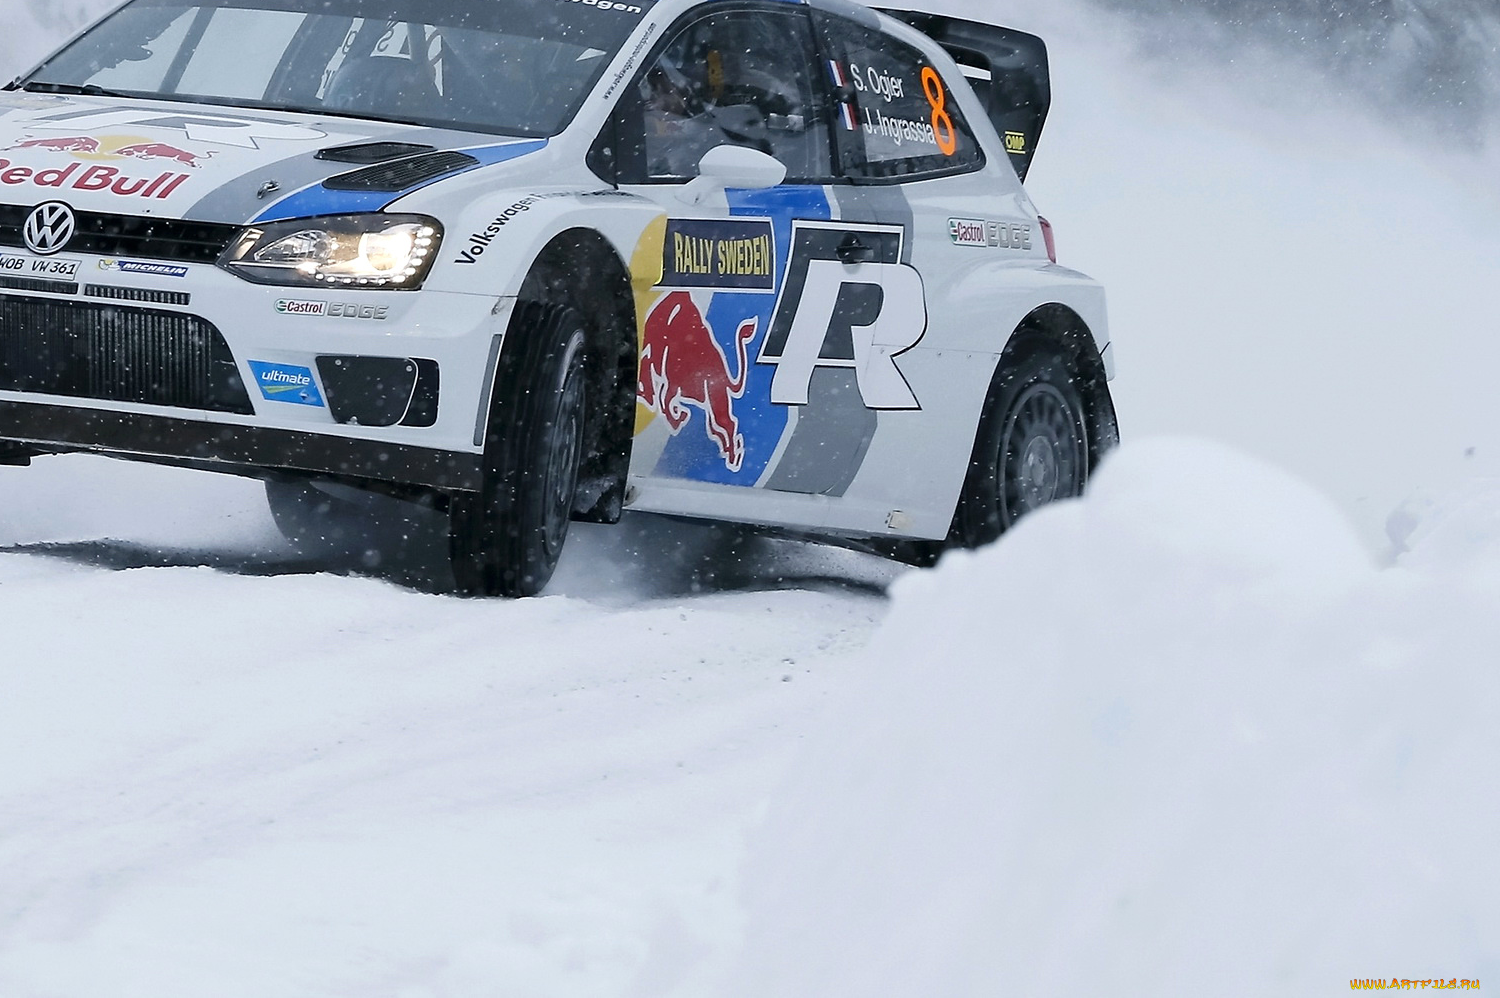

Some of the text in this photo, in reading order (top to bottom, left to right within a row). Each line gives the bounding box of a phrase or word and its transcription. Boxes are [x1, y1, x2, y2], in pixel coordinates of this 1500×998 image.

[850, 63, 904, 102] S. Ogier
[863, 107, 937, 146] J. Ingrassia
[921, 66, 956, 156] 8
[1005, 134, 1025, 150] OMP
[71, 164, 191, 200] Bull
[454, 193, 540, 266] Volkswagen
[957, 221, 1032, 250] Castrol EDGE
[123, 262, 187, 274] MICHELIN
[674, 231, 770, 275] RALLY SWEDEN
[287, 301, 389, 320] Castrol EDGE
[766, 252, 928, 411] R
[261, 369, 311, 386] ultimate
